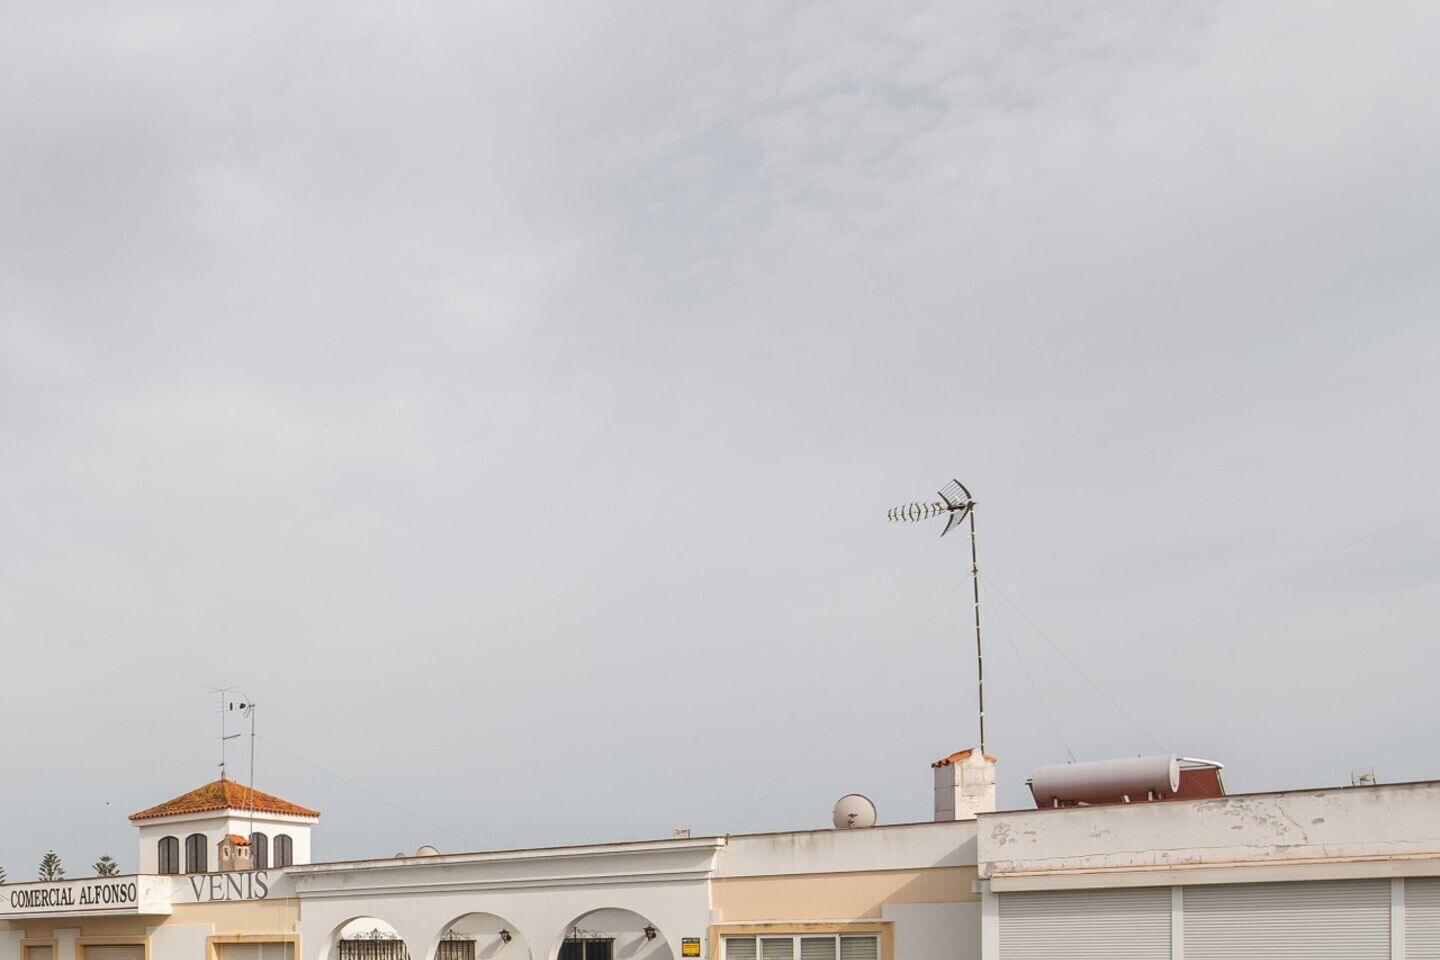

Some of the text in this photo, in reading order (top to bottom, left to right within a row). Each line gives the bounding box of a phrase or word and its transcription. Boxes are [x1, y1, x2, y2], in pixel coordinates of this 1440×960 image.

[10, 882, 137, 908] COMERCIAL ALFONSO
[188, 871, 269, 902] VENIS
